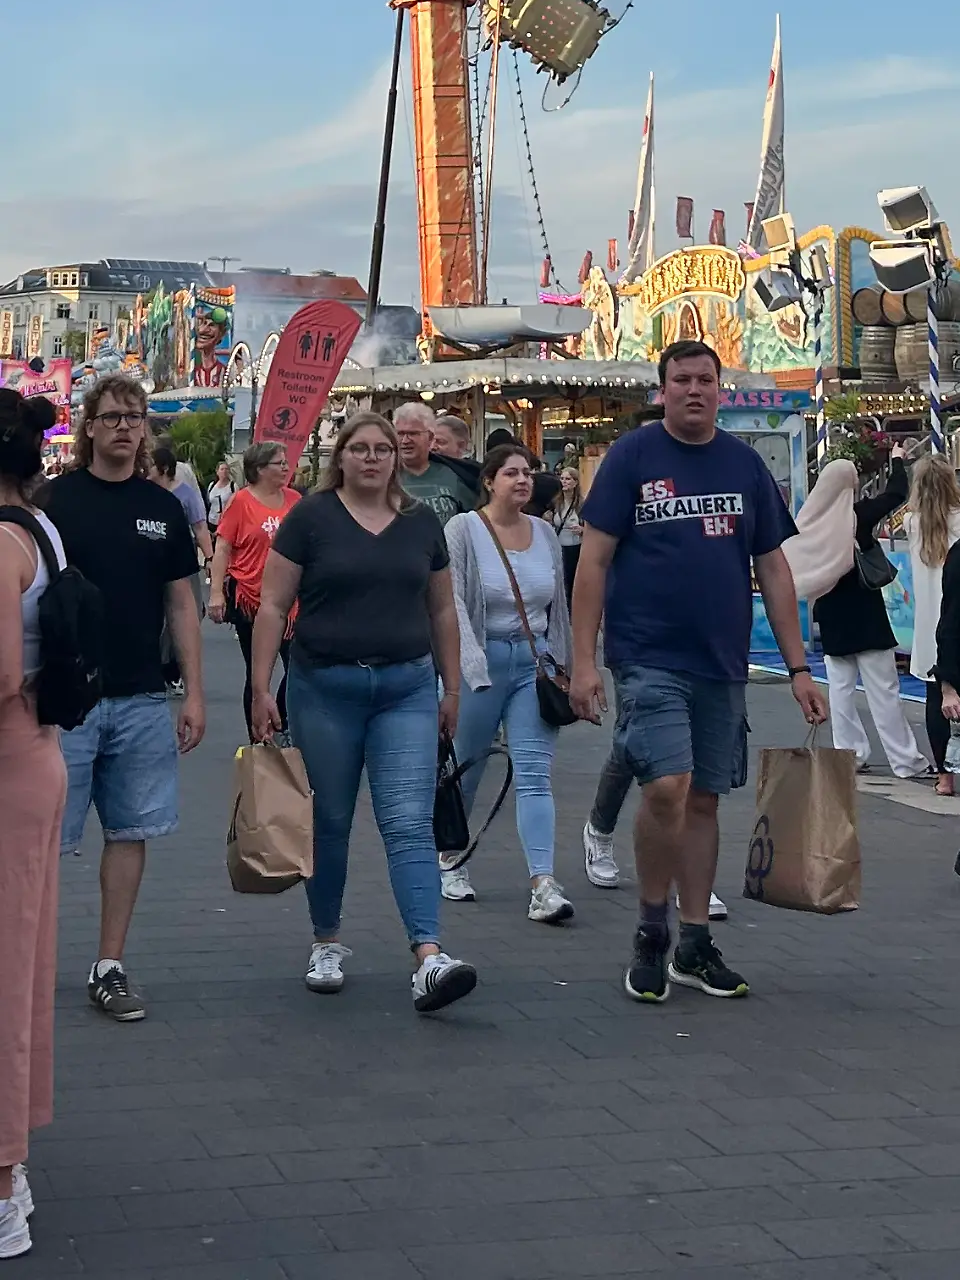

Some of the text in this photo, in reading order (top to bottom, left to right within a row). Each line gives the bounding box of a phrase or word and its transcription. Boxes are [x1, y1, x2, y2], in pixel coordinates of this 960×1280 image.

[278, 368, 325, 383] Restroom
[289, 394, 307, 404] WC
[719, 391, 784, 407] KASSE
[642, 480, 675, 502] ES.
[637, 495, 742, 522] ESKALIERT.
[136, 519, 167, 536] CHASE
[703, 516, 734, 535] EH.
